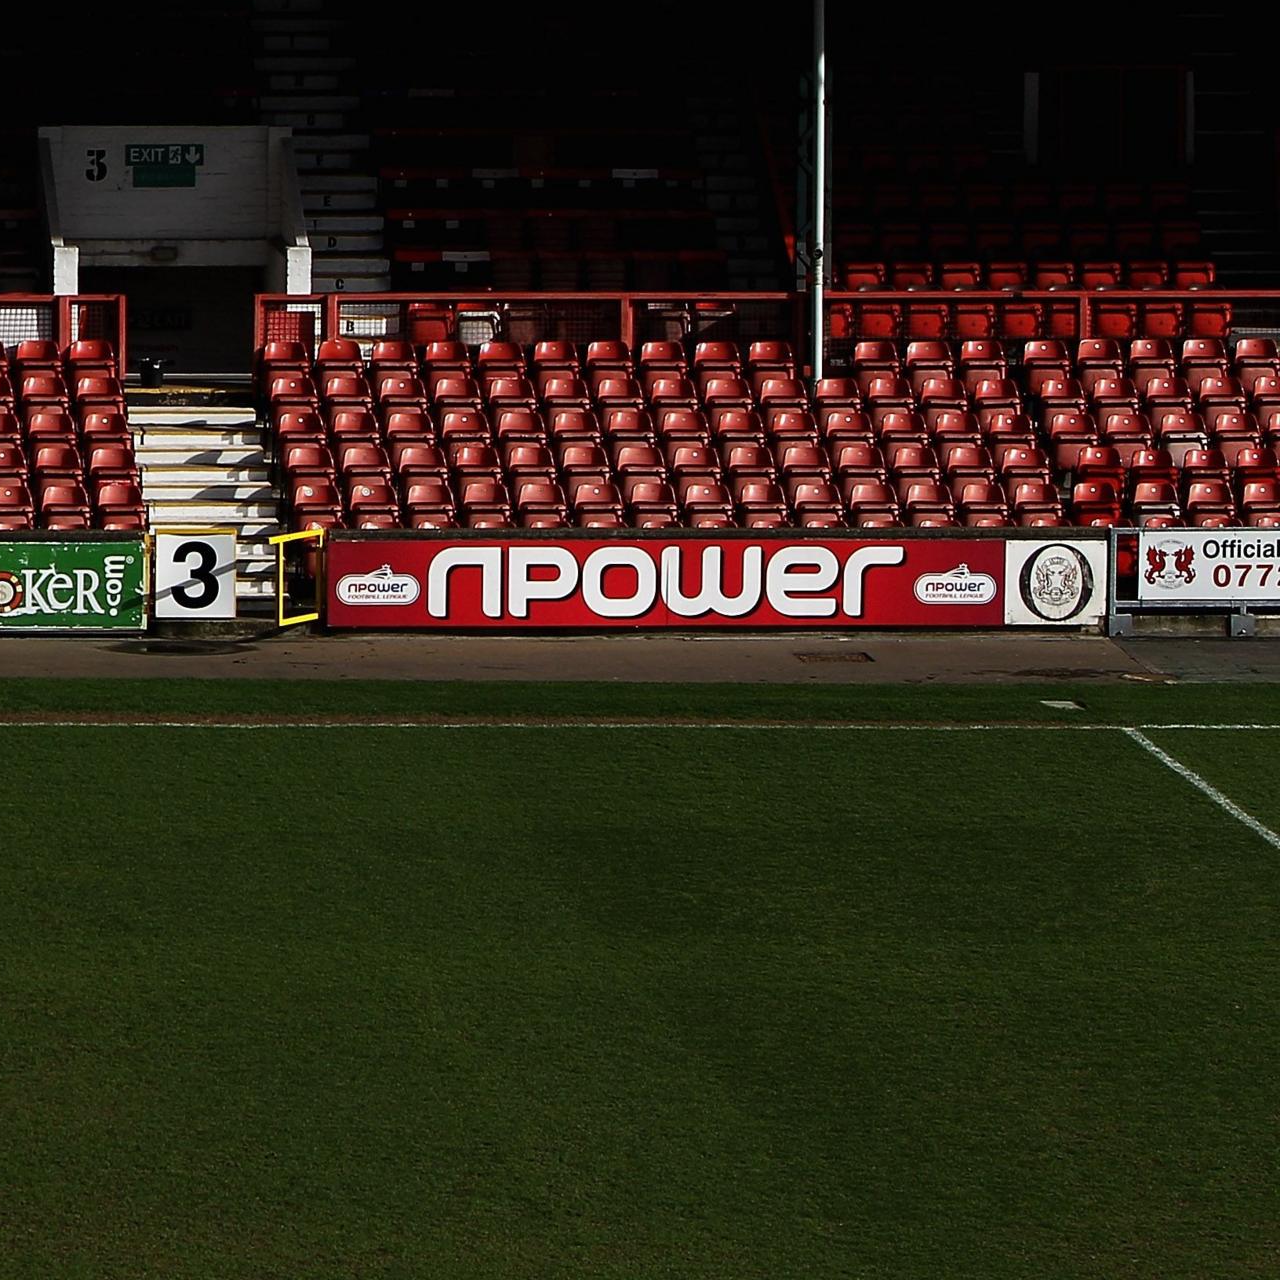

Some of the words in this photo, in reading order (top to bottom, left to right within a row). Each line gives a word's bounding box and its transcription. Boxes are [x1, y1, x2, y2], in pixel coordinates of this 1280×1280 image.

[129, 147, 166, 163] EXIT
[85, 149, 108, 183] 3
[335, 278, 345, 291] C
[345, 320, 354, 332] B
[171, 540, 219, 609] 3
[427, 545, 905, 618] npower
[1212, 564, 1280, 588] 077
[347, 583, 409, 593] npower
[925, 582, 986, 592] npower
